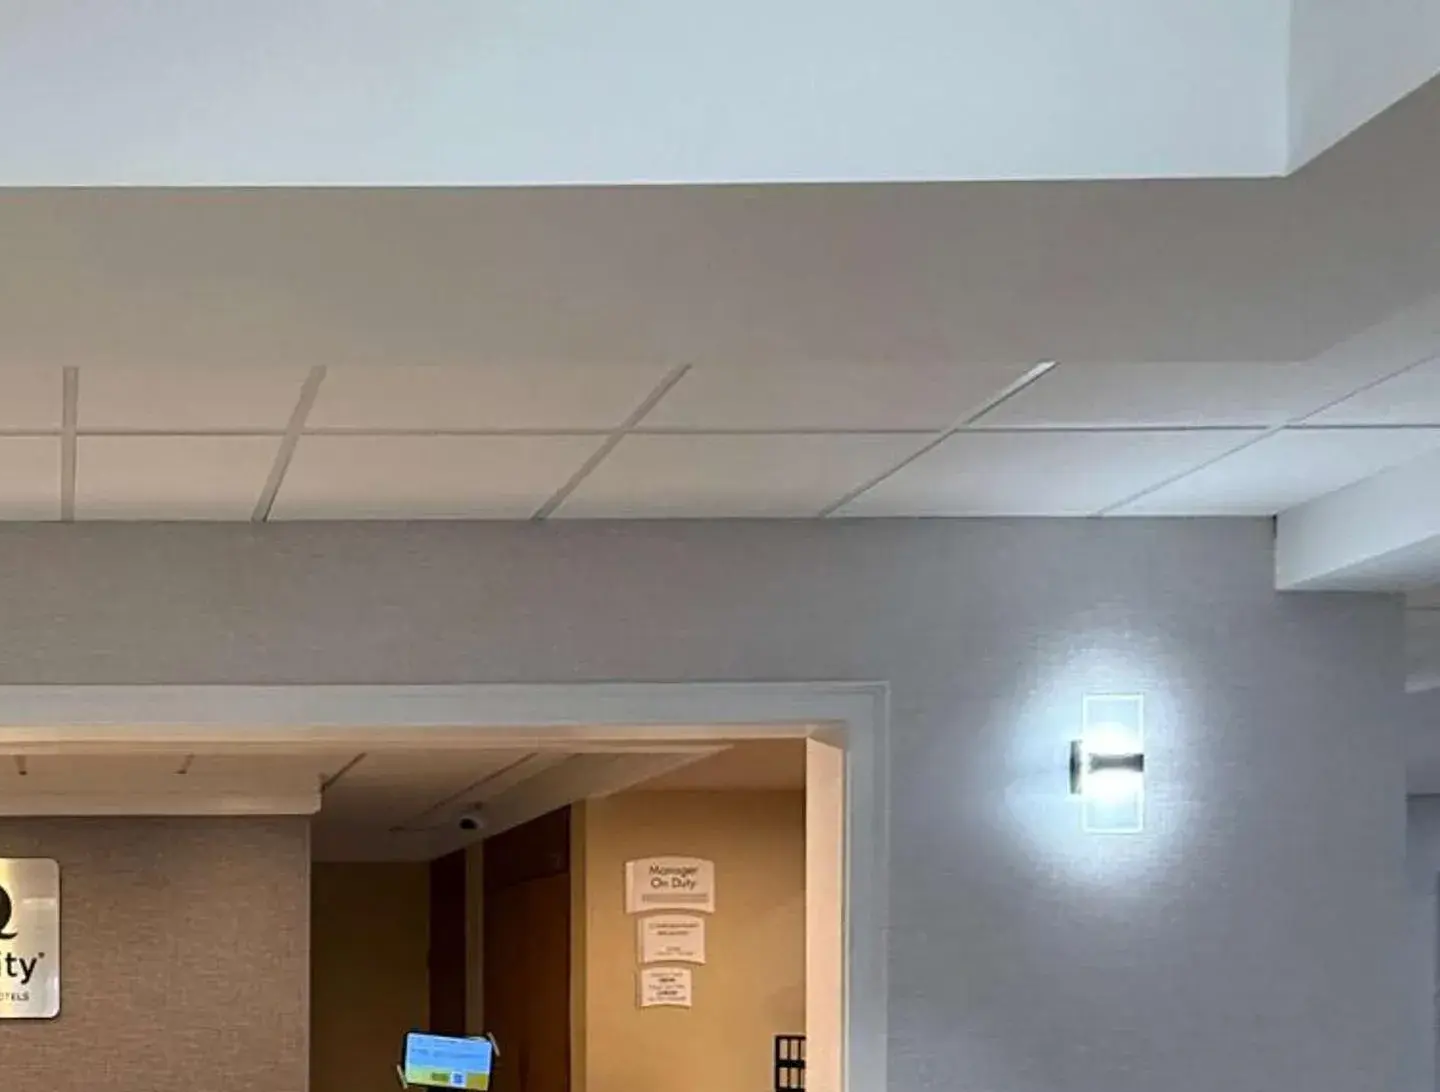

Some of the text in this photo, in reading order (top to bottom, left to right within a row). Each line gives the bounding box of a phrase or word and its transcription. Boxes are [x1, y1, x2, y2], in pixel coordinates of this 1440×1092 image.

[648, 864, 699, 878] Manager
[650, 876, 697, 891] On Duty
